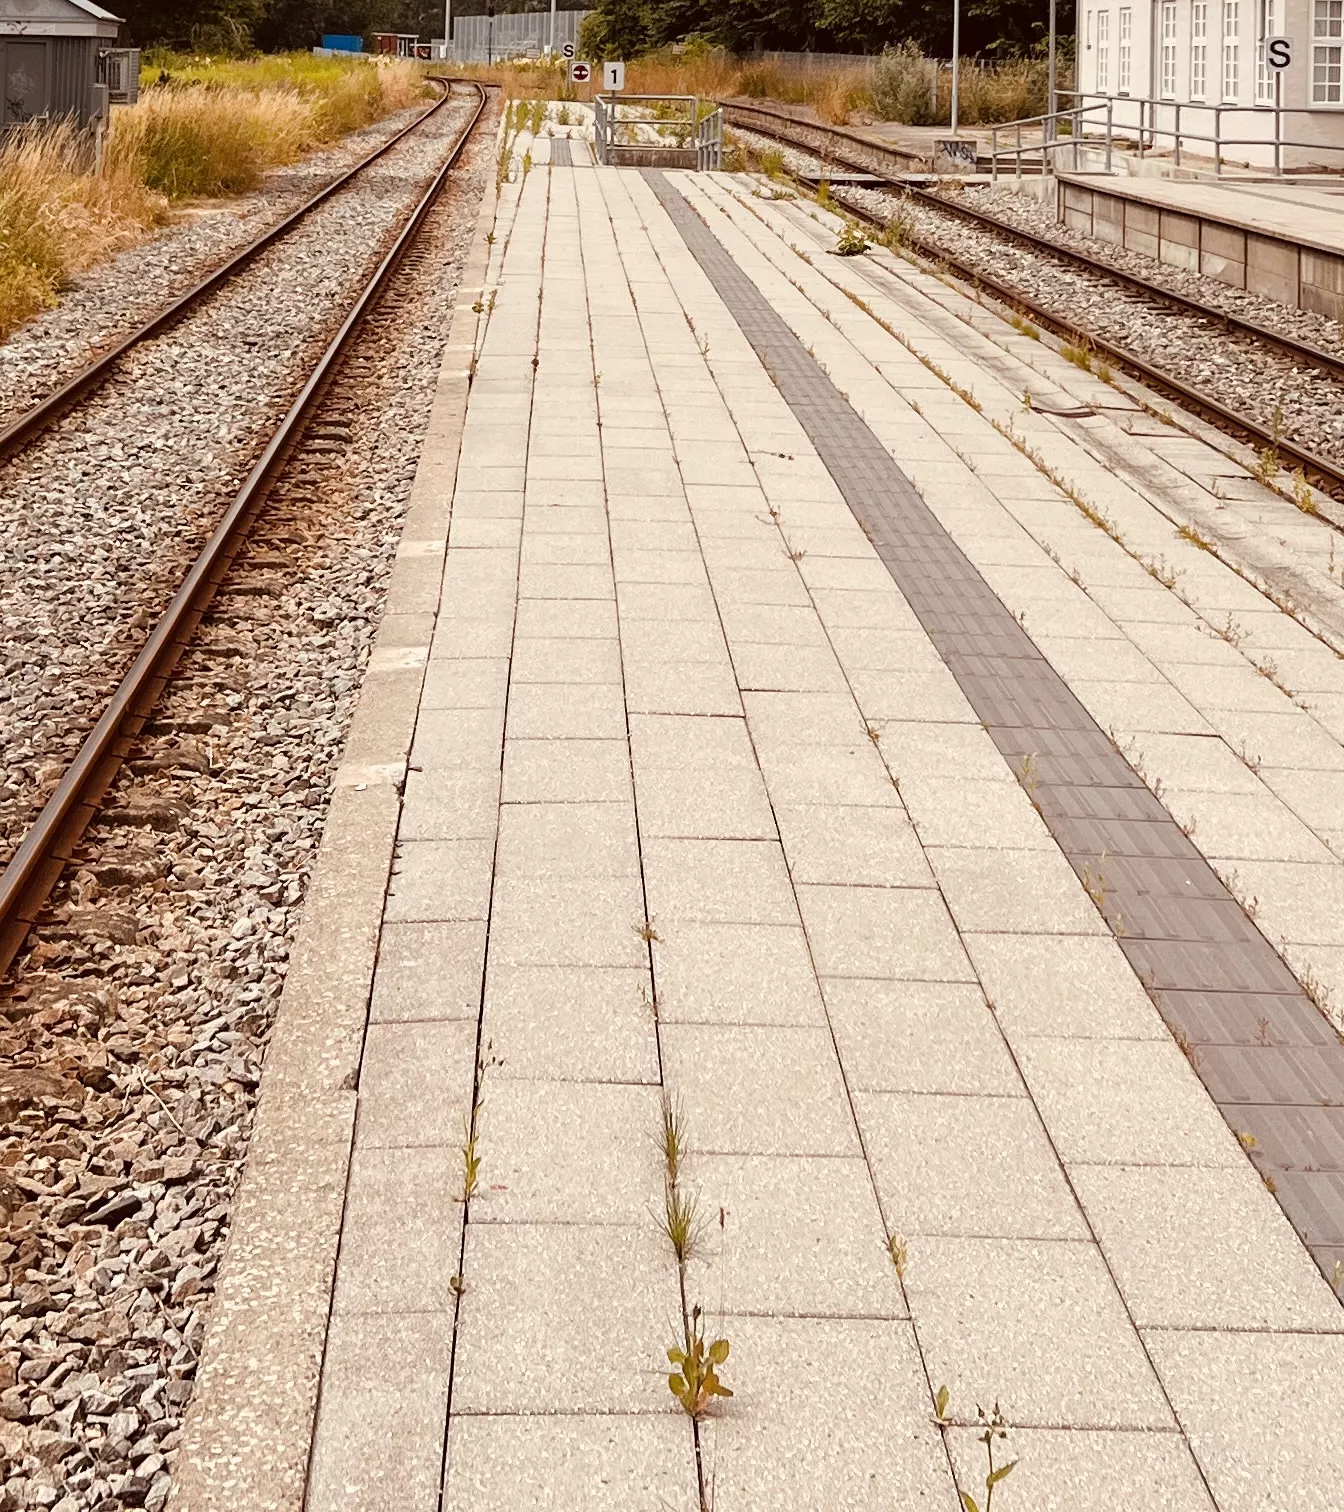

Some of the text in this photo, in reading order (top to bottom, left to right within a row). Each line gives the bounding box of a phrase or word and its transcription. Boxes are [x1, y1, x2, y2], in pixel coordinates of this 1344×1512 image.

[563, 44, 574, 58] S
[1269, 39, 1291, 68] S
[611, 69, 617, 84] 1
